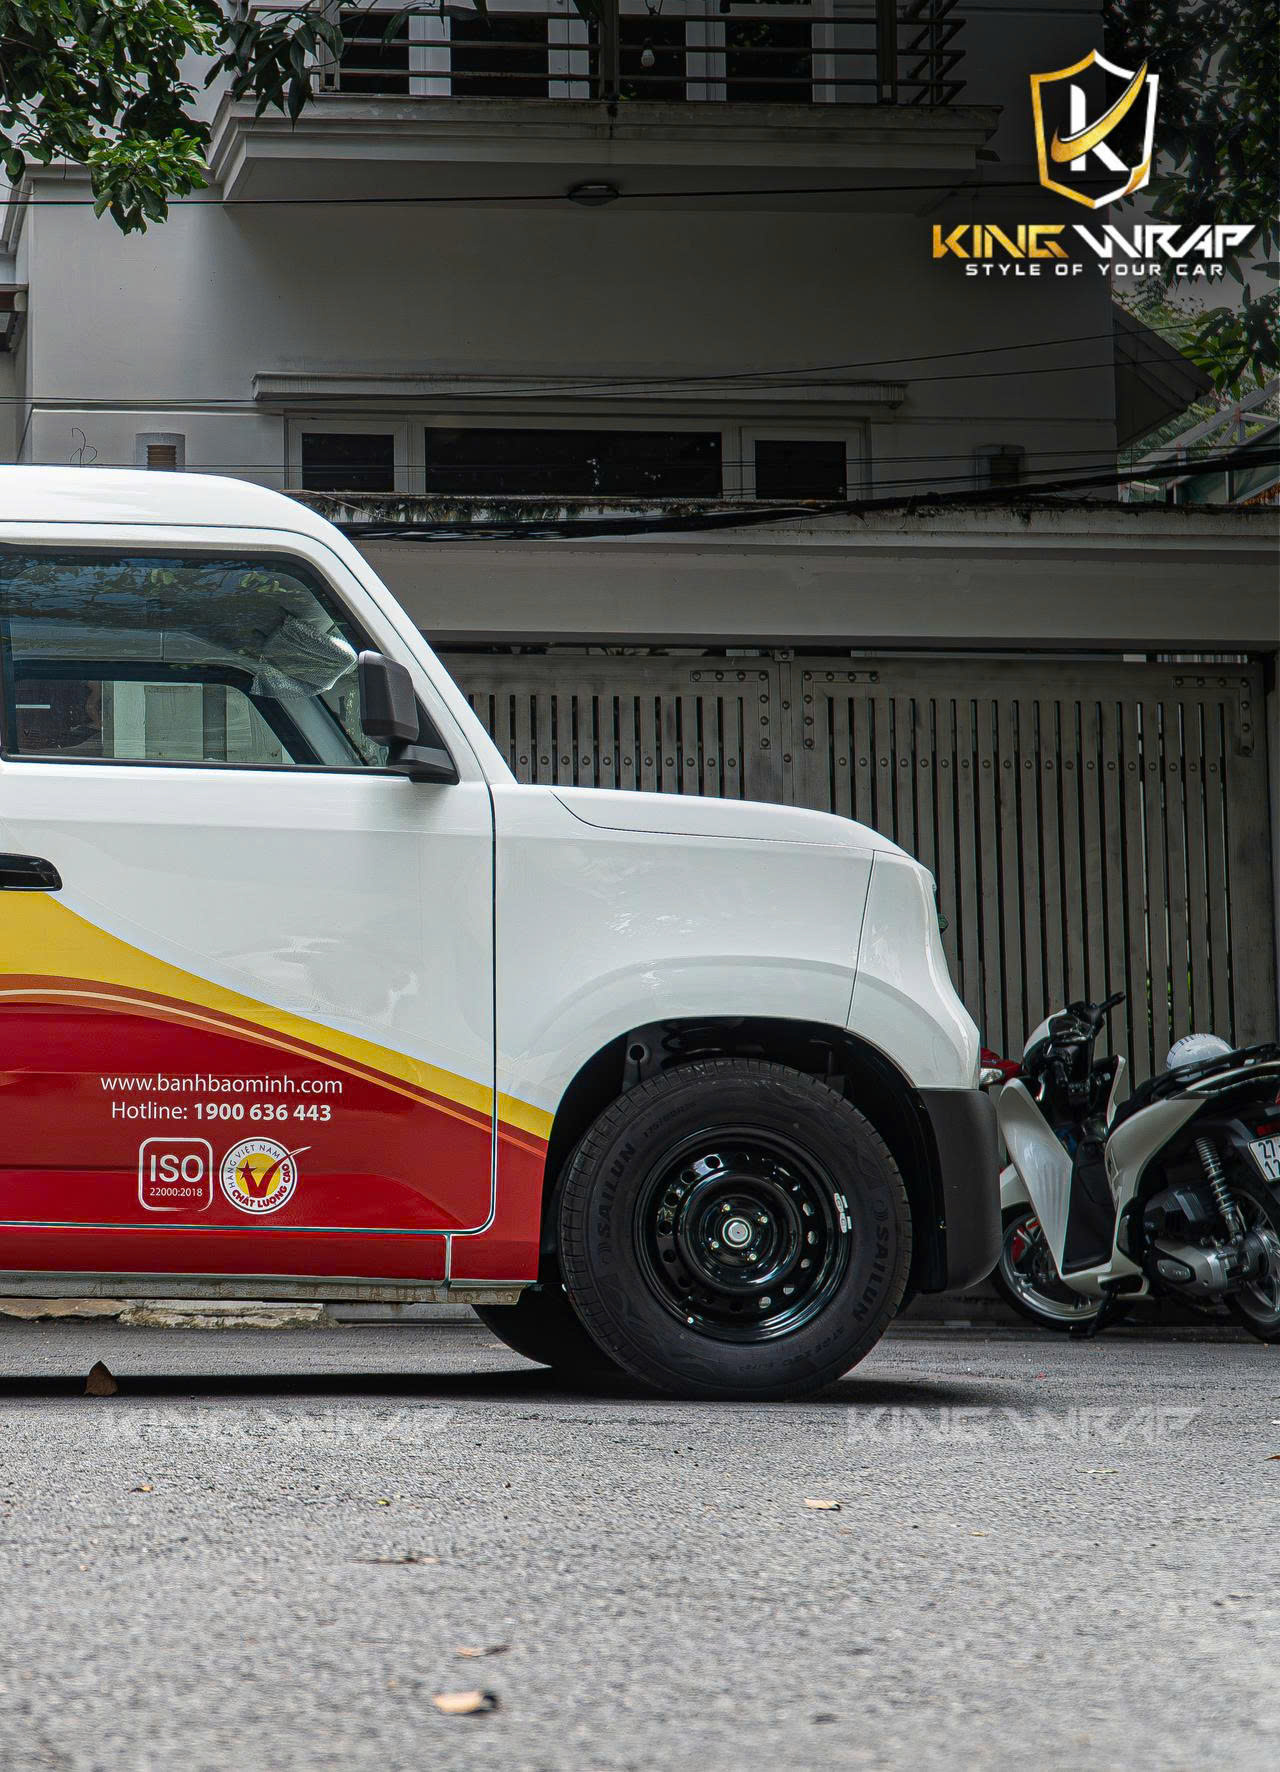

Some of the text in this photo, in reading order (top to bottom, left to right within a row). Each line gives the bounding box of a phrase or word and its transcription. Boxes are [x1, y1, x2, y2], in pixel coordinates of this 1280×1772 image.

[101, 1073, 343, 1094] www.banhbaominh.com
[111, 1102, 332, 1121] Hotline: 1900 636 443
[260, 1144, 280, 1158] NAM
[149, 1154, 204, 1183] ISO
[282, 1163, 291, 1183] CAO
[149, 1187, 203, 1197] 22000:2018
